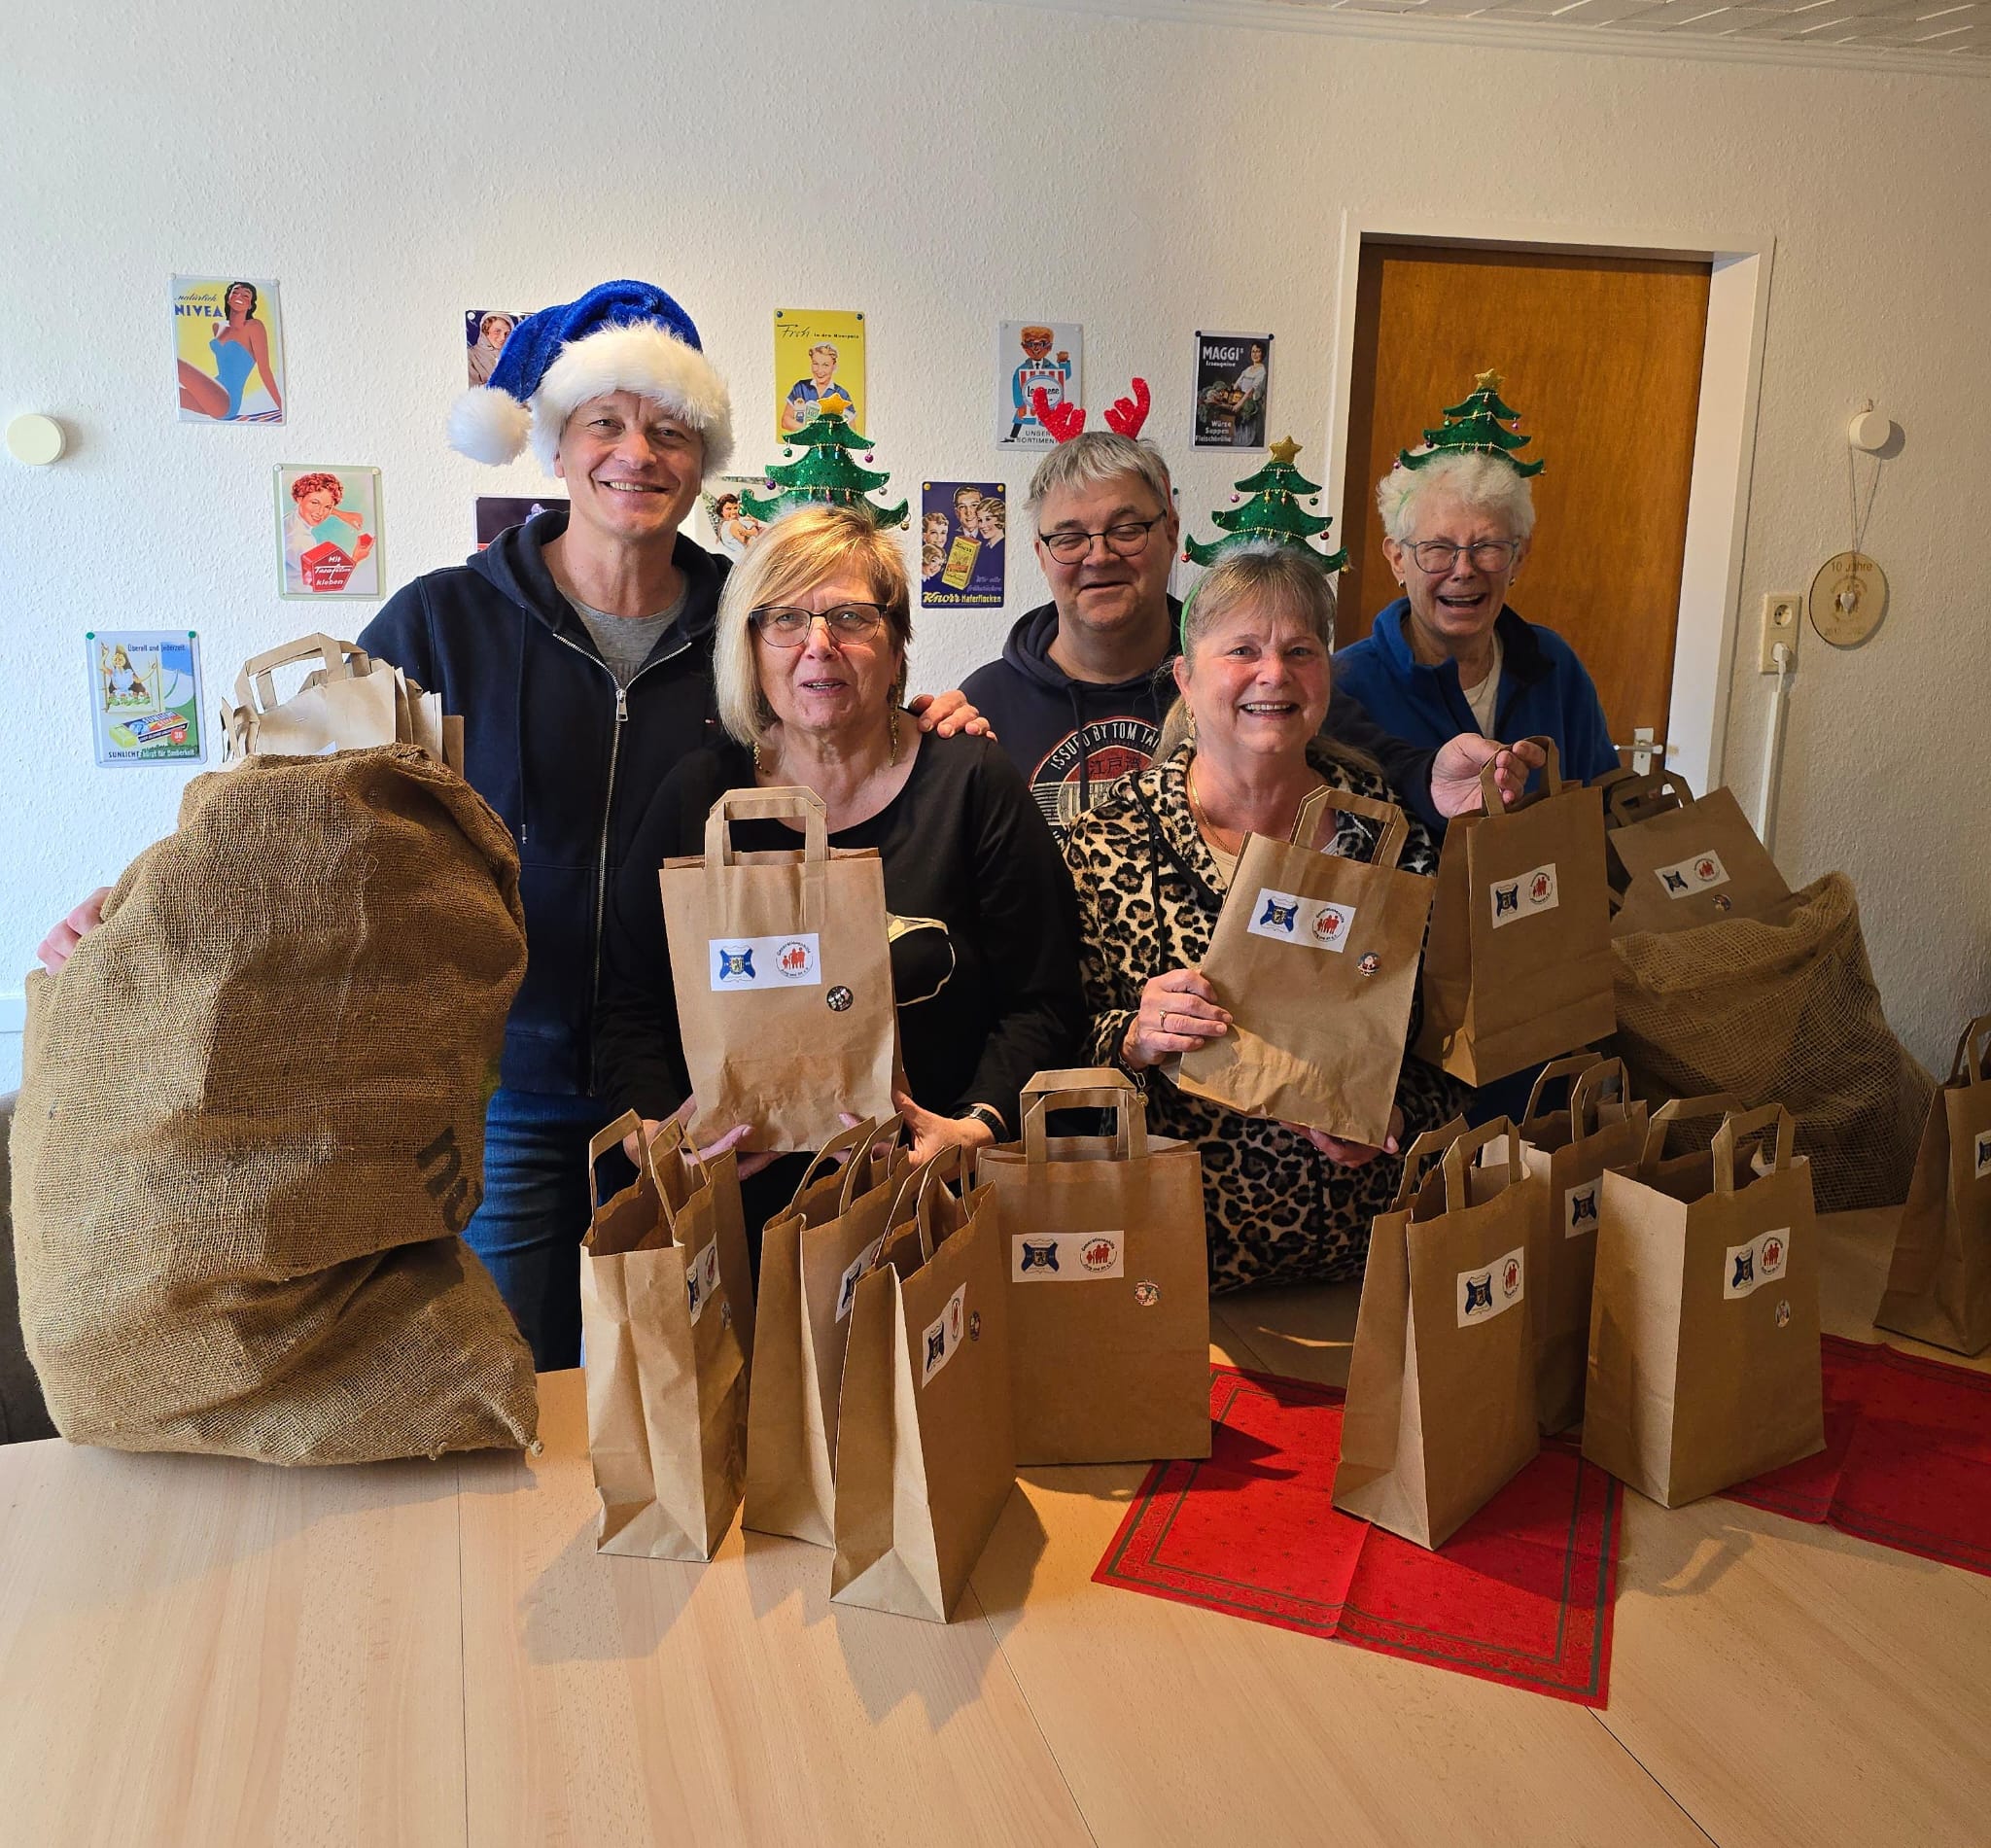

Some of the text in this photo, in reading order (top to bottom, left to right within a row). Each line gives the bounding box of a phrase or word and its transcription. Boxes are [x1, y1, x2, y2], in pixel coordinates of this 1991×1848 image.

[174, 303, 224, 317] NIVEA
[1832, 560, 1872, 573] 10 Jhre
[922, 591, 1001, 603] Knorr Haferflocken
[1092, 724, 1106, 742] BY
[1112, 722, 1137, 741] TOM
[108, 750, 140, 759] SUNLICHT
